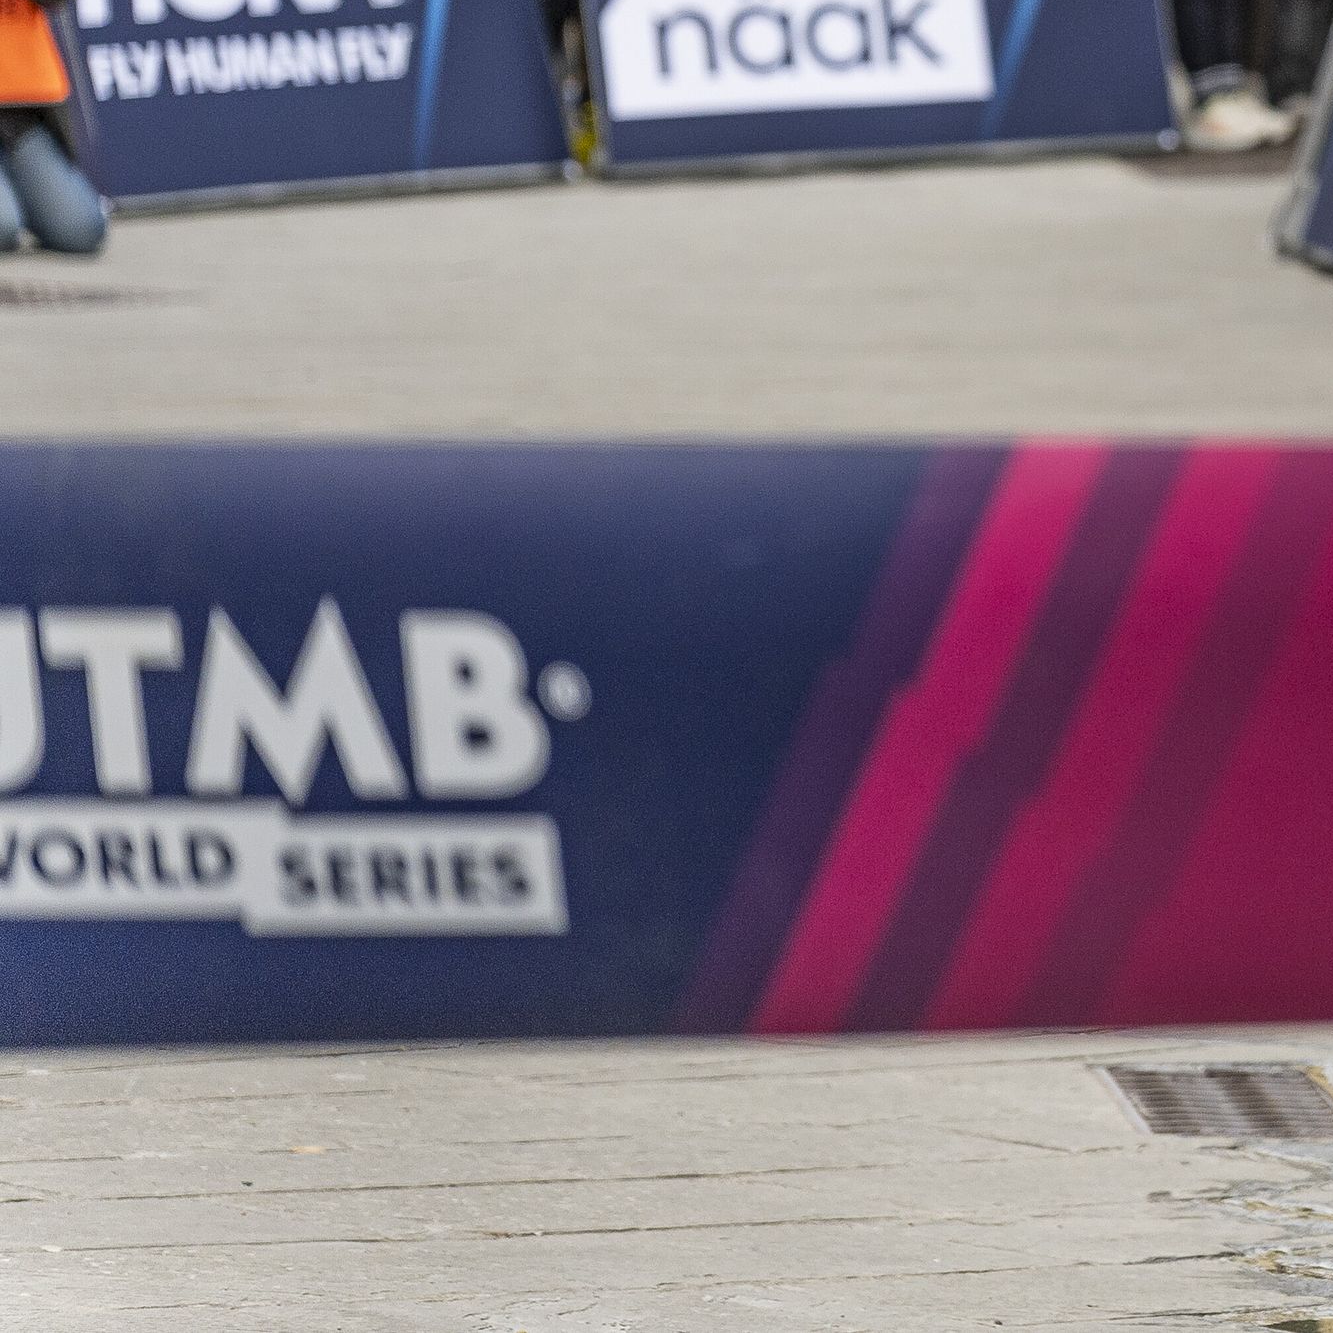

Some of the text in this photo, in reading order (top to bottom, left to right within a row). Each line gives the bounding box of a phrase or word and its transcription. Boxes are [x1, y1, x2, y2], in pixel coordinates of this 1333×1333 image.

[87, 21, 415, 102] FLY HUMAN FLY
[0, 826, 532, 908] ORLD SERIES
